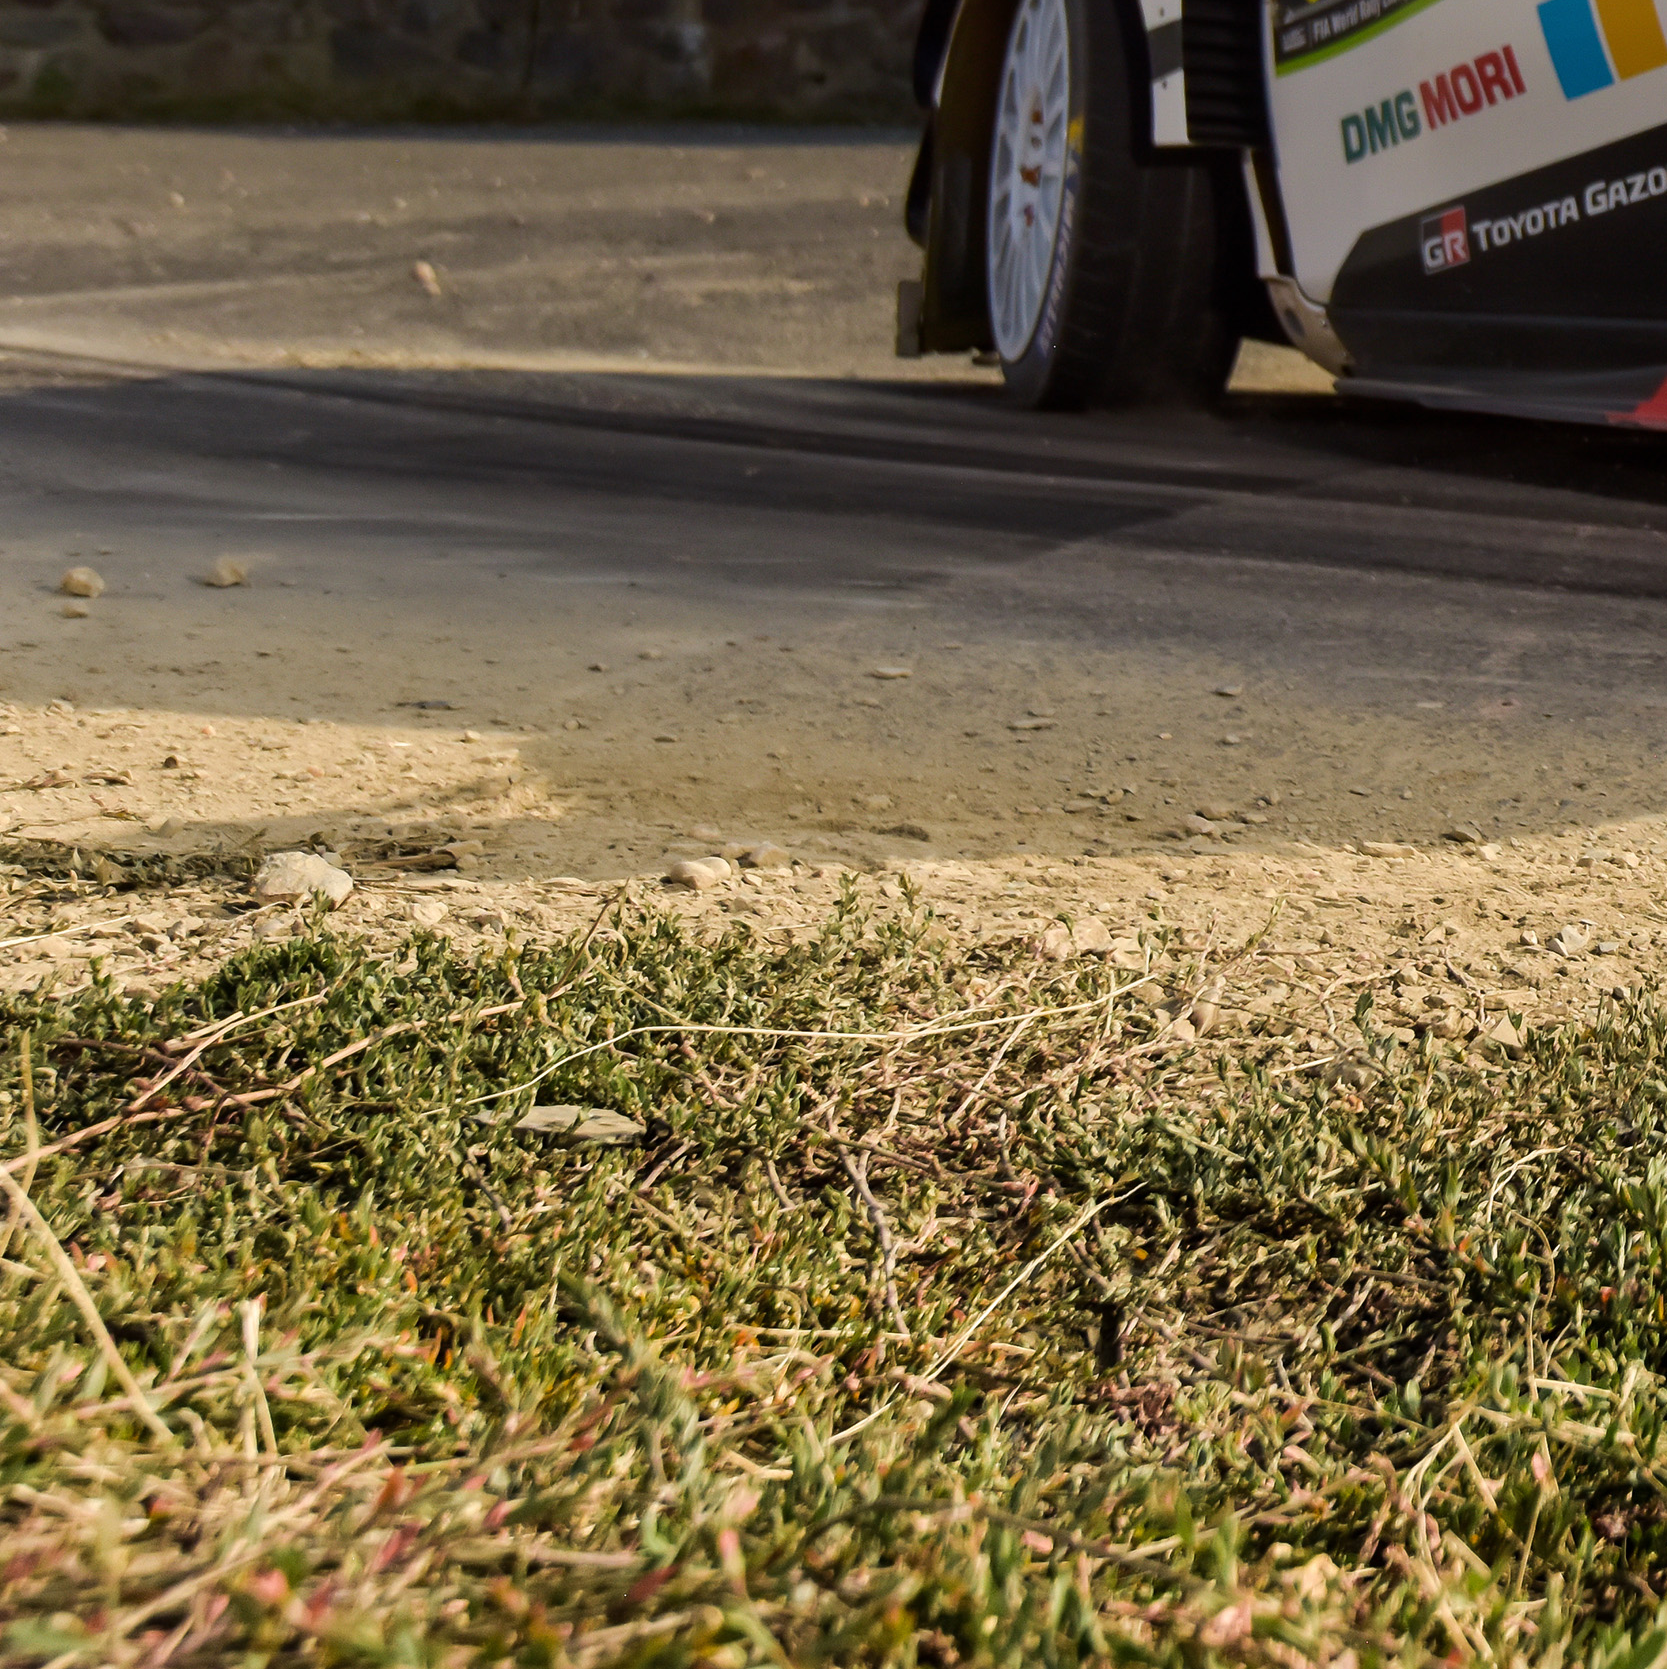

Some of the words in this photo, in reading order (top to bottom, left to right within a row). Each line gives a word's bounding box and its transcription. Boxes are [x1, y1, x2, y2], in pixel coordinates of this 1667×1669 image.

[1340, 87, 1423, 165] DMG
[1418, 43, 1528, 132] MORI
[1423, 231, 1467, 268] GR
